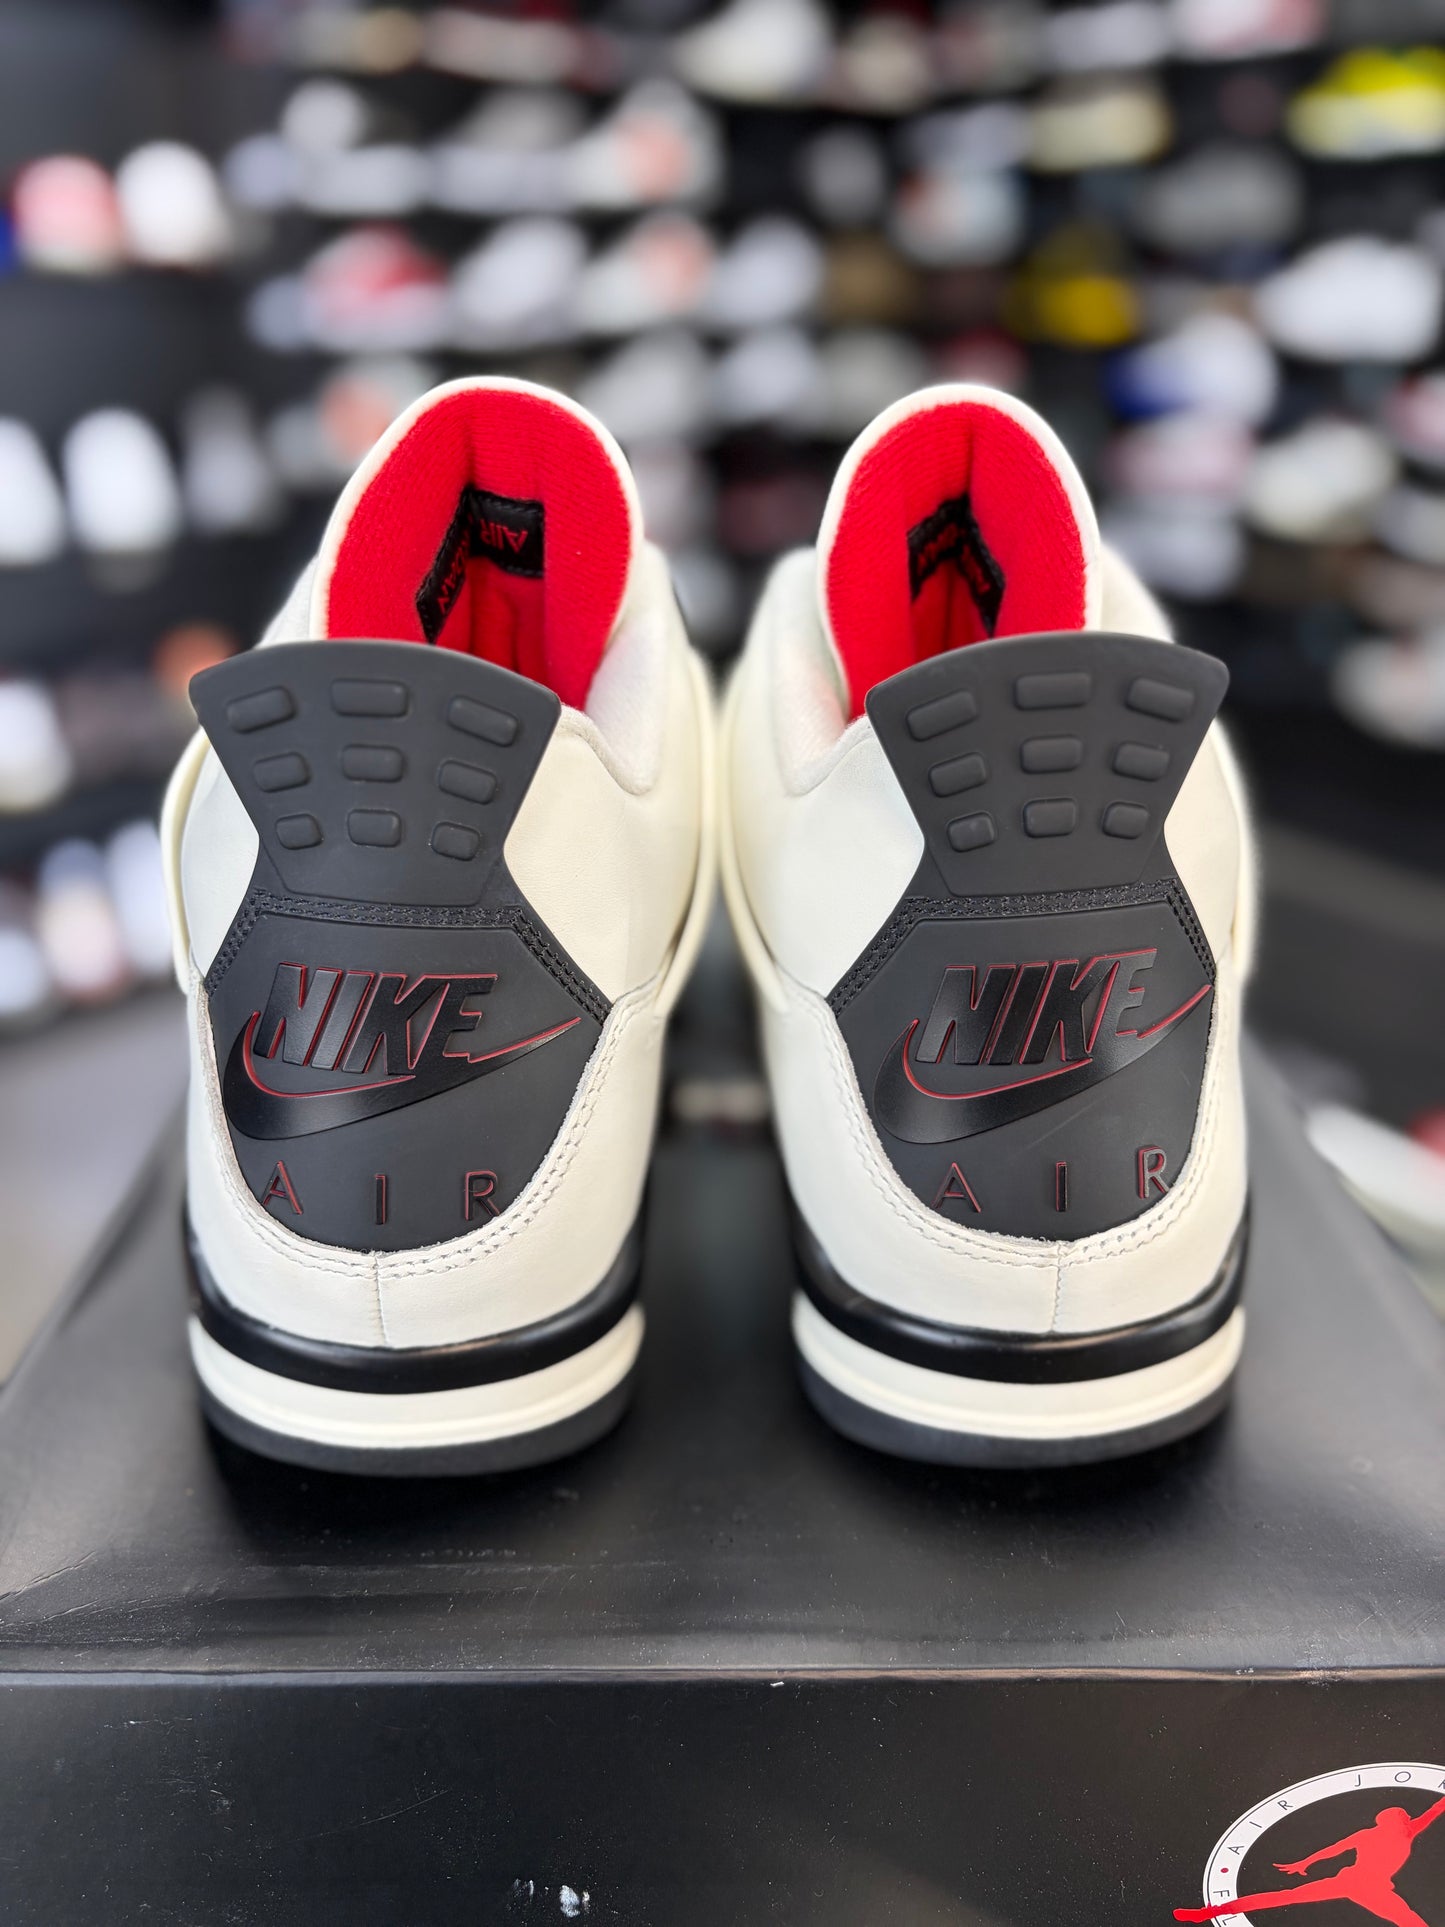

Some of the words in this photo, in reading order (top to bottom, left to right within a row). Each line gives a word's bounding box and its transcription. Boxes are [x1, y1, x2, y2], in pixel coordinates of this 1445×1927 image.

[480, 518, 528, 553] AIR
[252, 960, 498, 1076] NIKE
[915, 947, 1158, 1066] NIKE
[261, 1160, 501, 1225] AIR
[932, 1145, 1170, 1213] AIR
[1227, 1798, 1294, 1856] AIR
